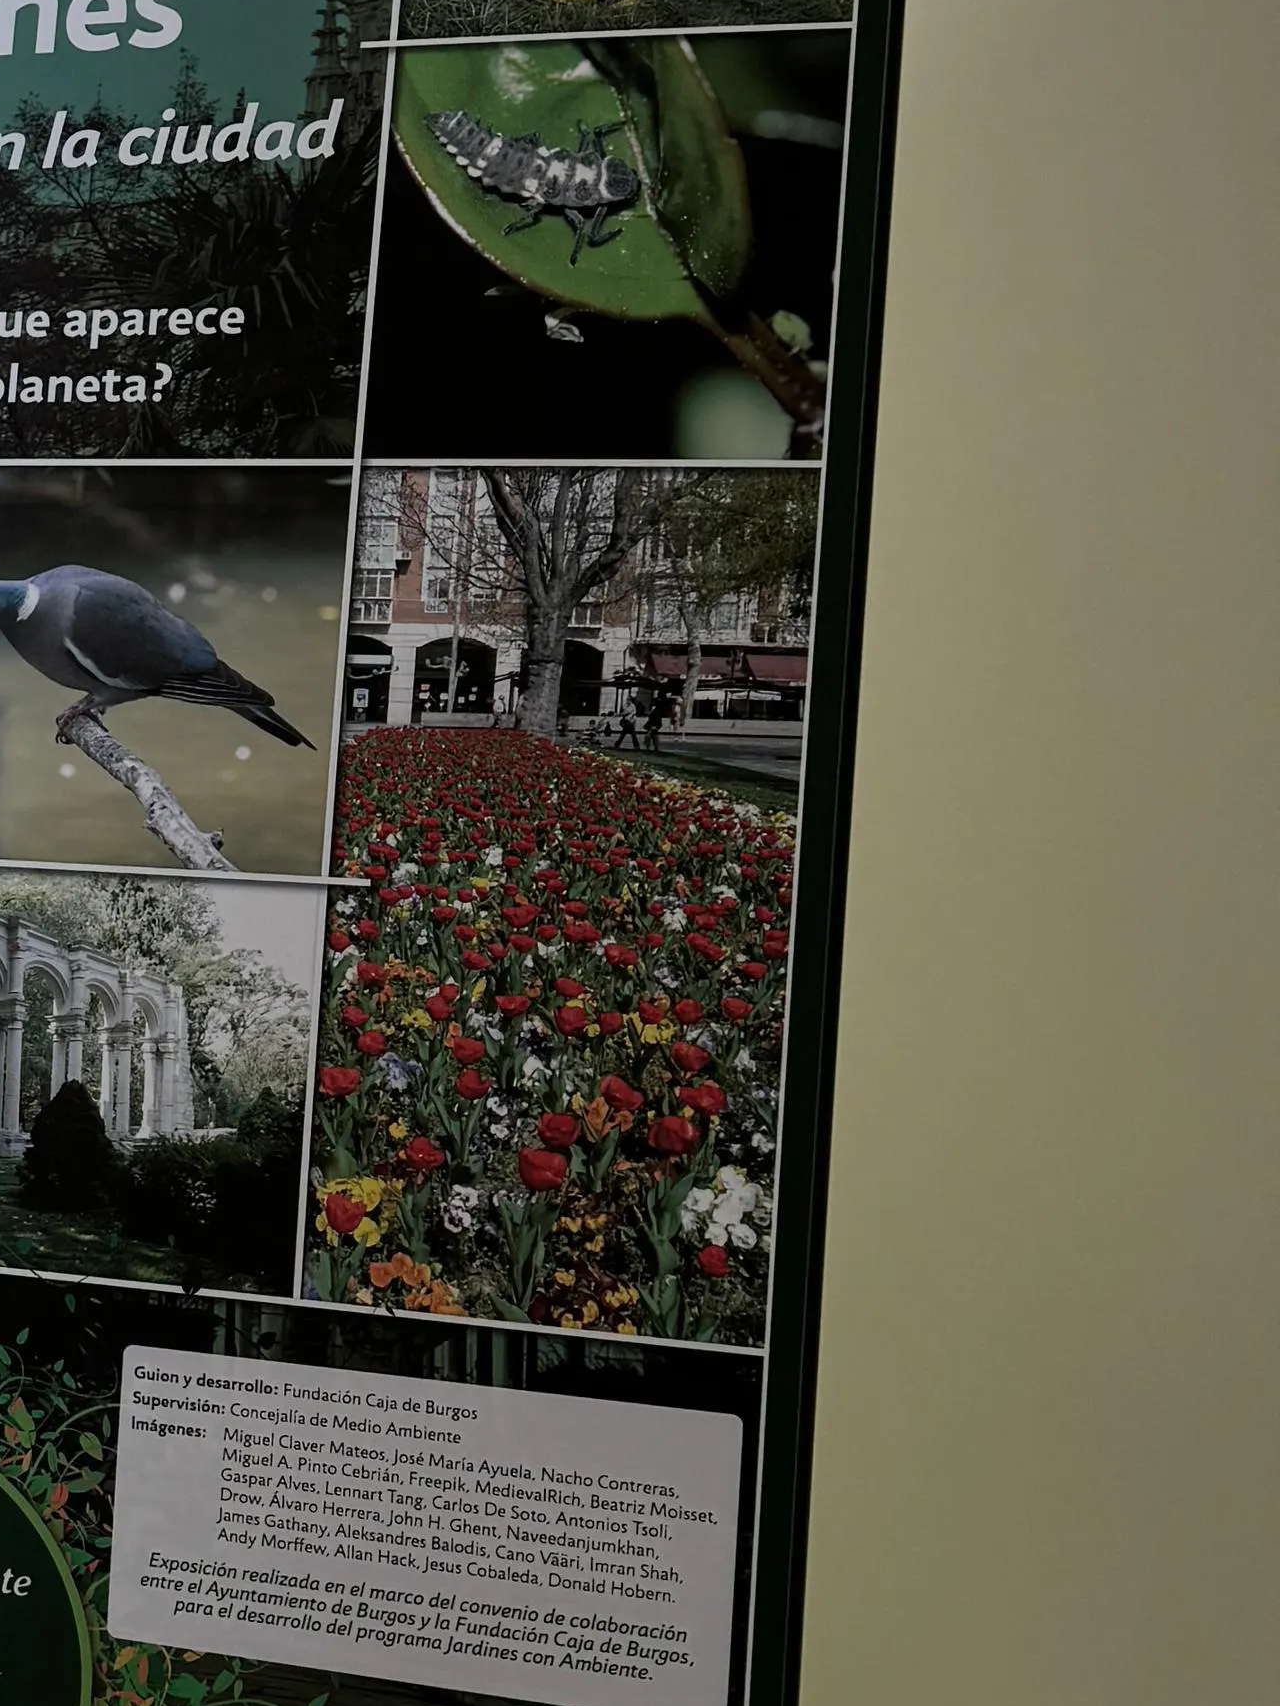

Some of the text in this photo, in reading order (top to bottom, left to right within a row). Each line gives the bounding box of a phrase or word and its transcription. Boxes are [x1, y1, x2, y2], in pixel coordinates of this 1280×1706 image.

[41, 110, 101, 169] la
[117, 97, 343, 168] ciudad
[63, 306, 245, 350] aparece
[132, 1390, 462, 1445] Supervisión: Concejalía de Medio Ambiente
[134, 1365, 478, 1422] Guion y desarrollo: Fundación Caja de Burgos
[131, 1415, 679, 1499] Imágenes: Miguel Claver Mateos, José María Ayuela, Nacho Contreras,
[222, 1447, 718, 1526] Miguel A. Pinto Cebrián, Freepik, MedievalRich, Beatriz Moisset,
[140, 1575, 694, 1667] entre el Ayuntamiento de Burgos y la Fundación Caja de Burgos,
[148, 1551, 687, 1643] Exposición realizada en el marco del convenio de colaboración
[173, 1600, 653, 1681] para el desarrollo del programa Jardines con Ambiente.
